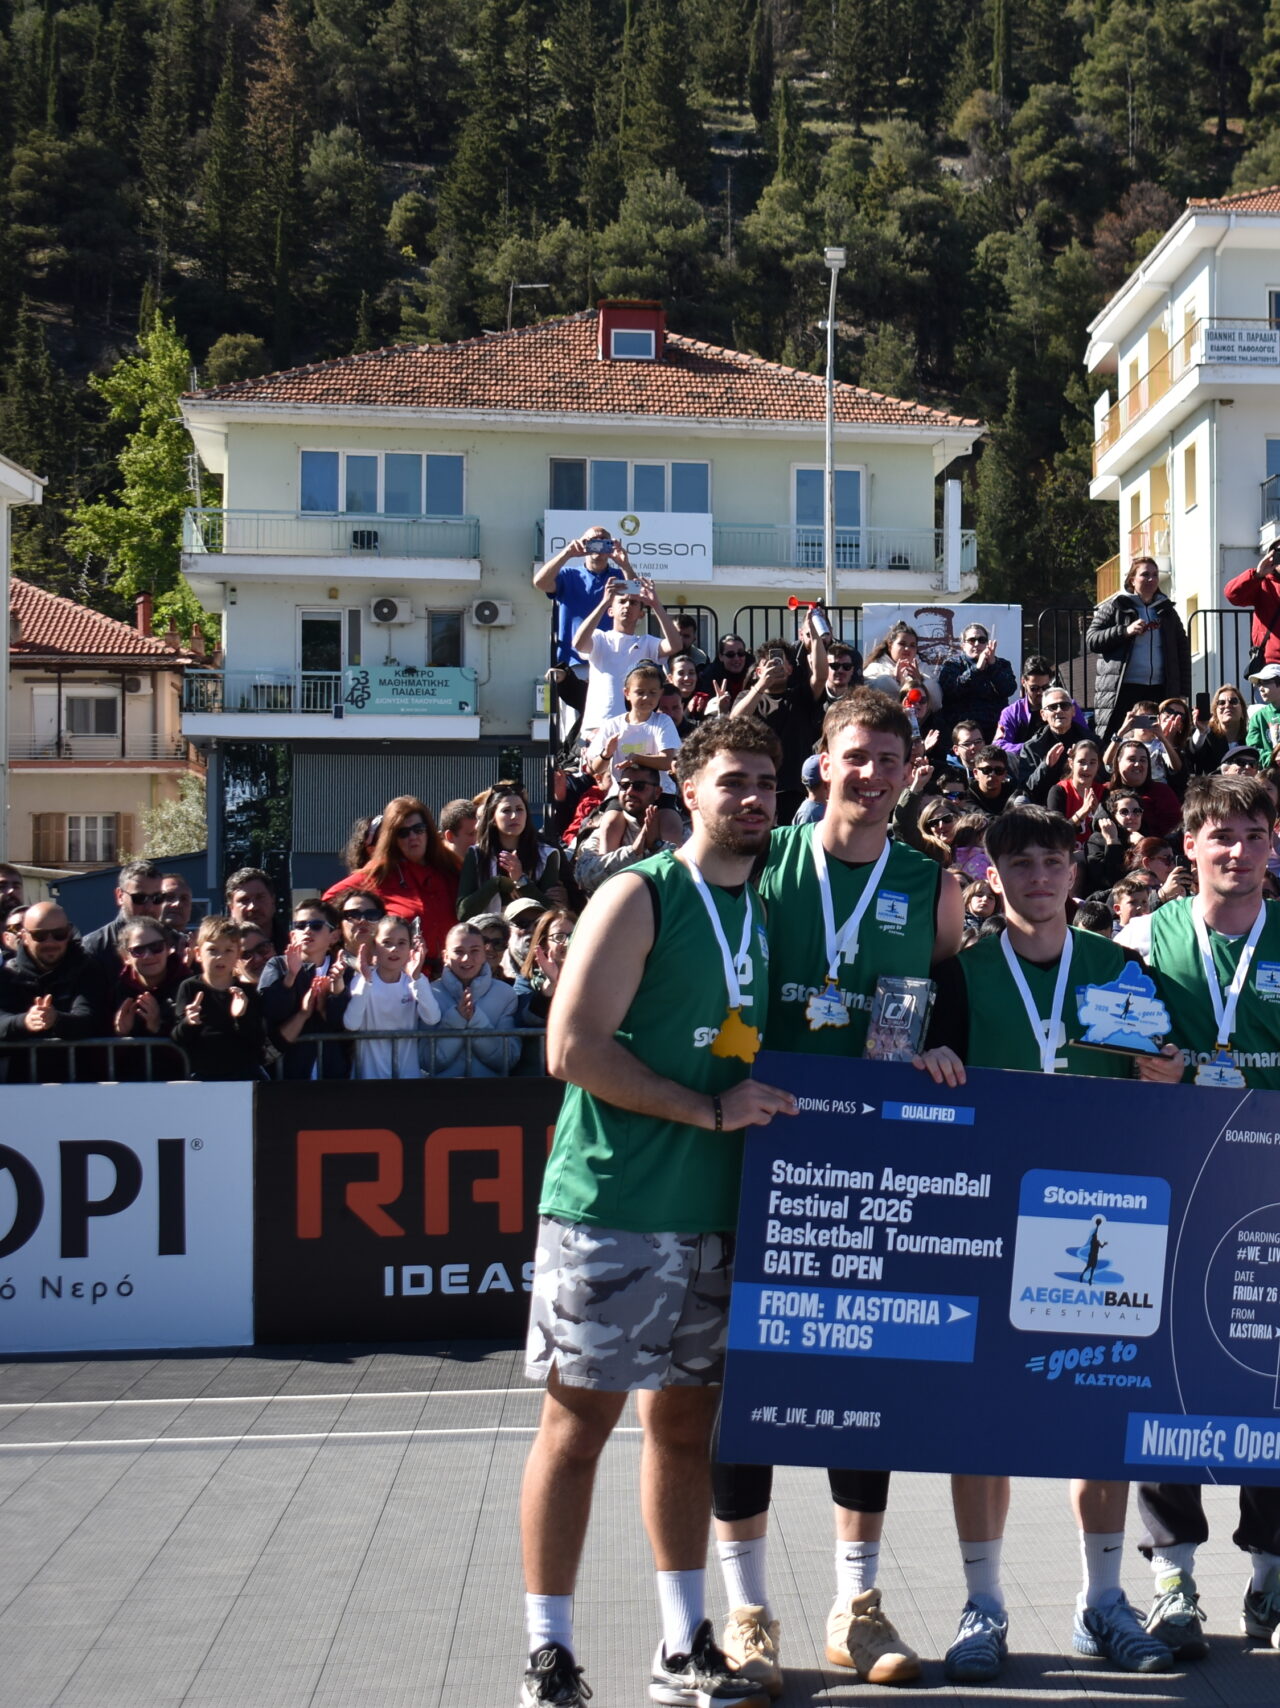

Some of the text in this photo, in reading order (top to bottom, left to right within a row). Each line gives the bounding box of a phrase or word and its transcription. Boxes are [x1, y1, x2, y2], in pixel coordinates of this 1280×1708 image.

[1210, 345, 1275, 353] ΕΙΔΙΚΟΣ ΠΑΘΟΛΟΓΟΣ
[378, 679, 450, 687] ΜΑΘΗΜΑΤΙΚΗΣ
[392, 687, 437, 696] ΠΑΙΔΕΙΑΣ
[832, 1099, 857, 1114] PASS
[902, 1104, 955, 1122] QUALIFIED
[1225, 1129, 1272, 1145] BOARDING
[296, 1126, 556, 1239] RA
[771, 1159, 992, 1199] Stoiximan AegeanBall
[768, 1190, 913, 1223] Festival 2026
[1043, 1186, 1148, 1210] Stoiximan
[765, 1220, 1004, 1258] Basketball Tournament
[1238, 1230, 1280, 1244] BOARDING
[763, 1250, 884, 1281] GATE: OPEN
[1234, 1270, 1255, 1283] DATE
[41, 1273, 135, 1305] Νερό
[1019, 1286, 1154, 1309] AEGEANBALL
[1233, 1285, 1264, 1302] FRIDAY
[1266, 1286, 1278, 1302] 26
[759, 1290, 940, 1325] FROM: KASTORIA
[1030, 1307, 1141, 1321] FESTIVAL
[1231, 1307, 1255, 1320] FROM
[758, 1319, 874, 1350] TO: SYROS
[1229, 1323, 1272, 1340] KASTORIA
[1047, 1340, 1137, 1380] goes to
[1075, 1373, 1152, 1388] ΚΑΣΤΟΡΙΑ
[751, 1406, 881, 1428] #WE_LIVE_FOR_SPORTS
[1141, 1419, 1226, 1462] Νικητές
